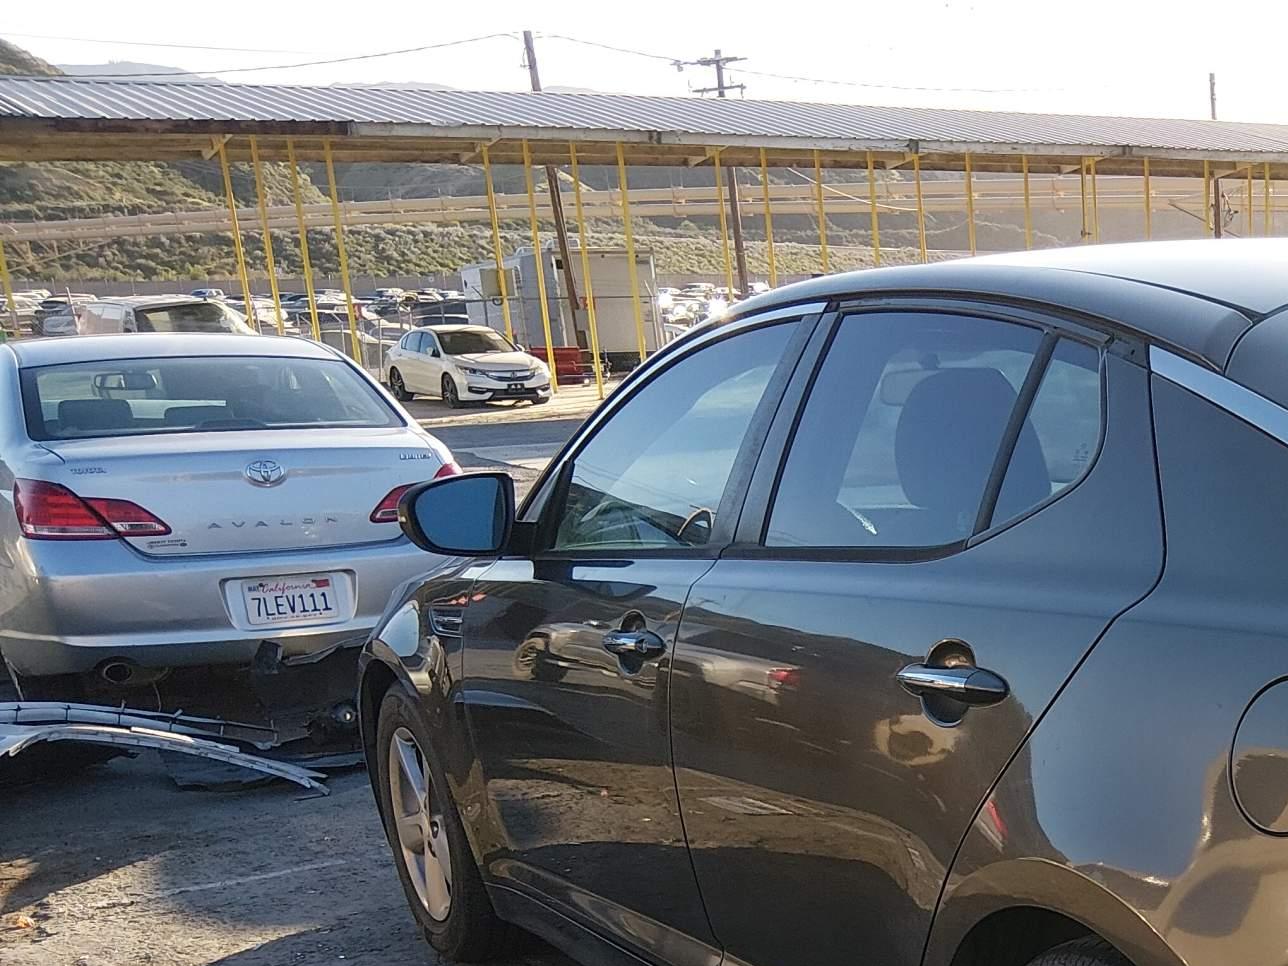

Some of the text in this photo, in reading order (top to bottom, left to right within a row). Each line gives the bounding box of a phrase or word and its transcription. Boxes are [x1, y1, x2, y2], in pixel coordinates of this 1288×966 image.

[208, 517, 337, 529] AVALON
[261, 583, 312, 594] California
[251, 592, 333, 618] 7LEV111
